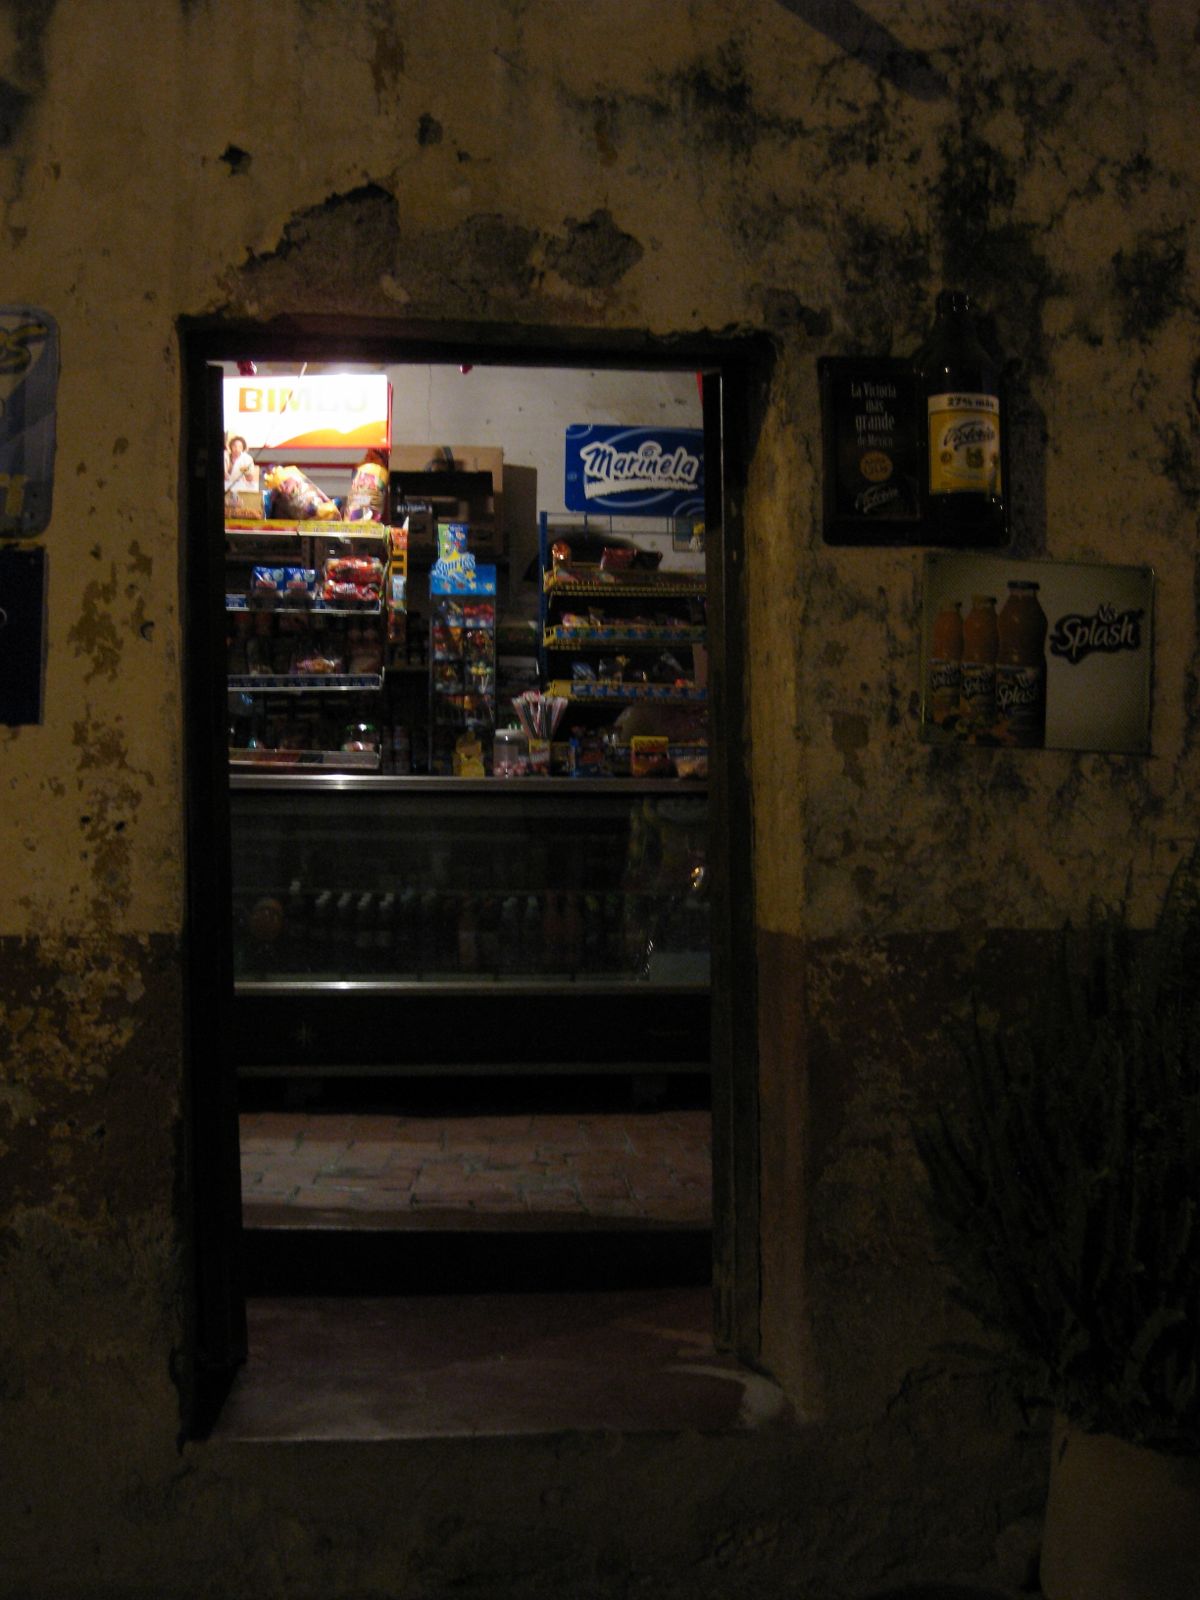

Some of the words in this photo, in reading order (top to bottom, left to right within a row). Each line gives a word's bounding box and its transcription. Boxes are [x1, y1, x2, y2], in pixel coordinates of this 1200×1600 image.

[855, 411, 895, 432] grande
[580, 440, 699, 485] Marinela
[1056, 614, 1137, 657] Splash
